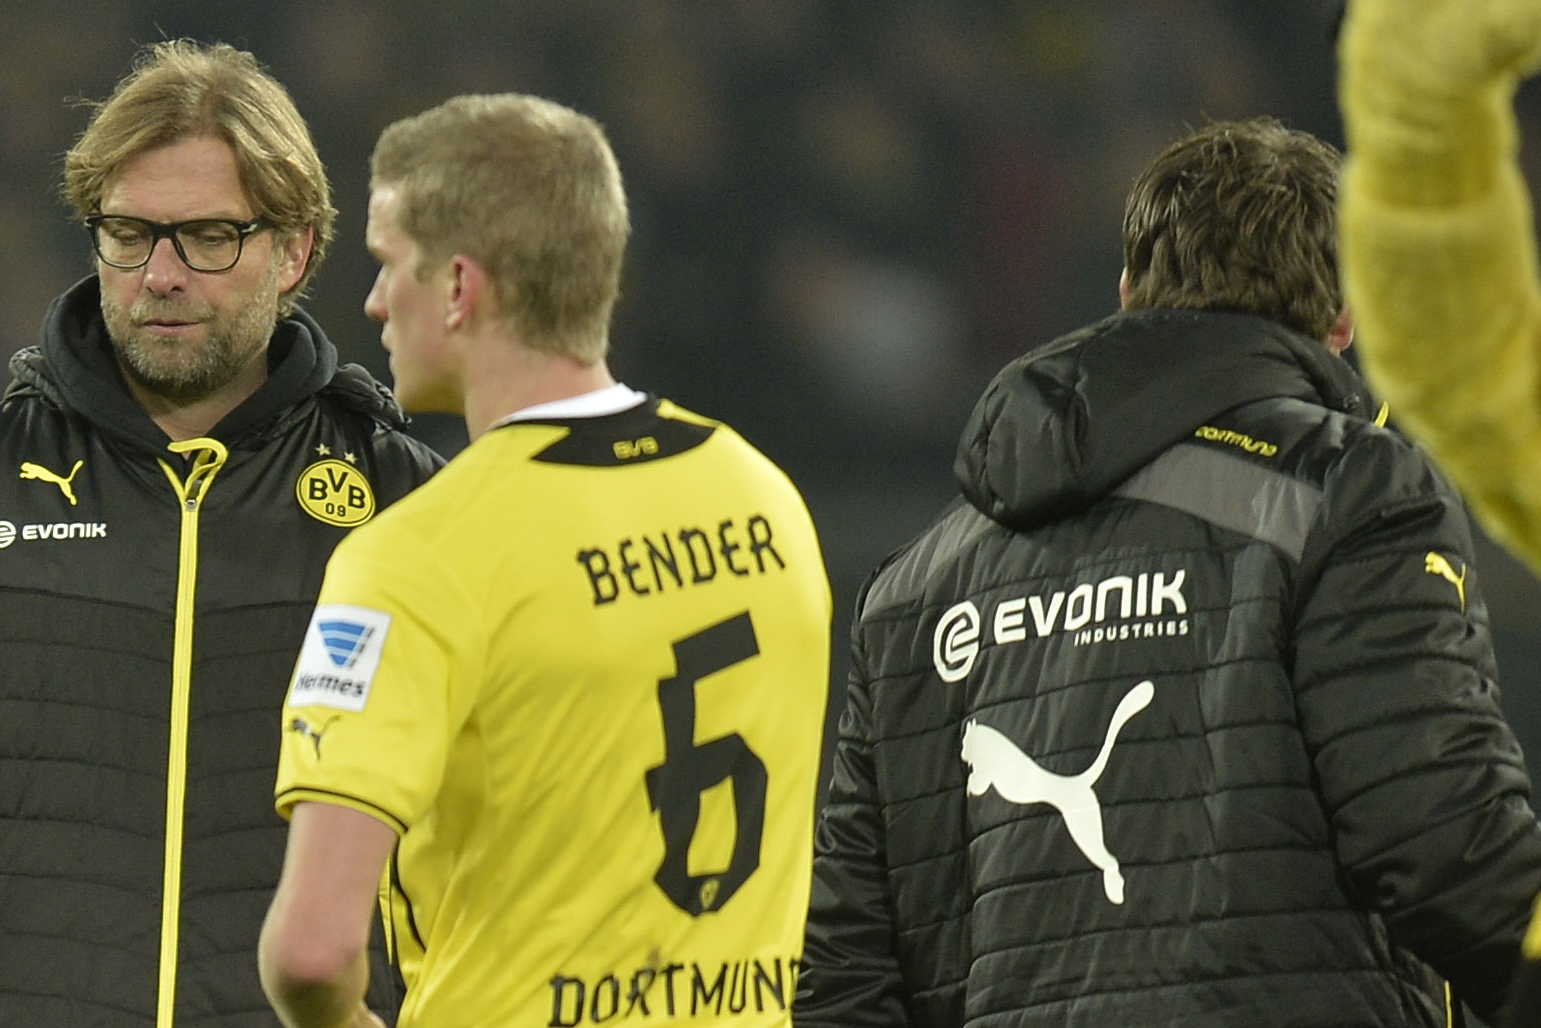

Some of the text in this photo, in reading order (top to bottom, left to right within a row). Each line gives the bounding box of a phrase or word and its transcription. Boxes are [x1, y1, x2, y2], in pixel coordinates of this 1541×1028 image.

[309, 467, 366, 509] BVB
[325, 502, 347, 517] 09
[22, 523, 107, 540] EVONIK
[576, 515, 786, 606] BENDER
[994, 569, 1187, 644] EVONIK
[1074, 619, 1189, 647] INDUSTRIES
[646, 610, 768, 917] 6
